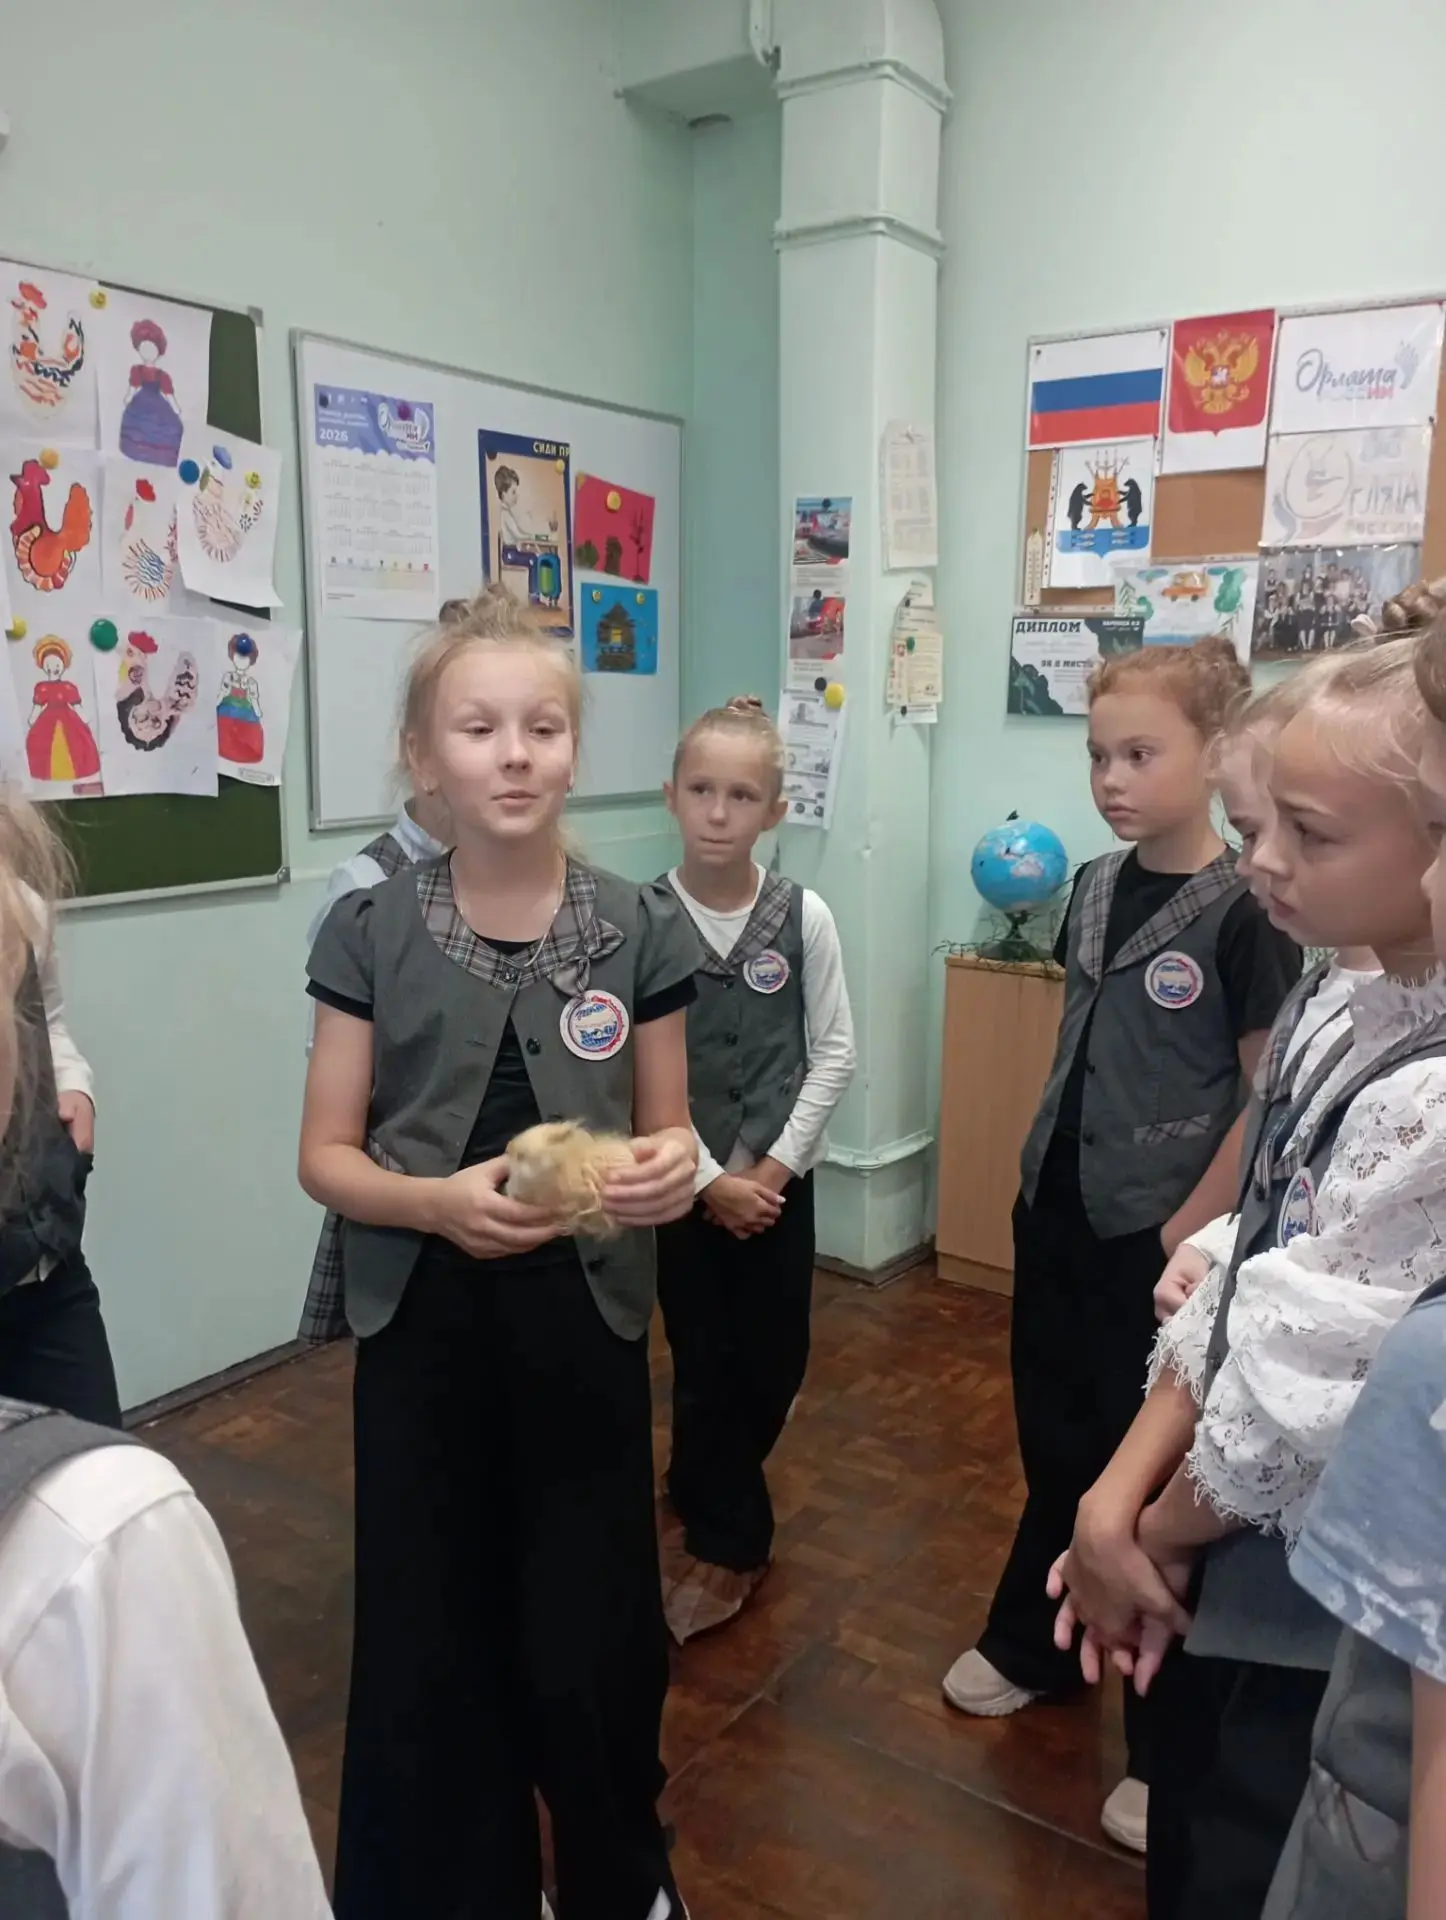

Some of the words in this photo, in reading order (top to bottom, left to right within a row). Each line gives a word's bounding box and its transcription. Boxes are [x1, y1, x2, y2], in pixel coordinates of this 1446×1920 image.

[1296, 348, 1398, 397] Орлята
[532, 441, 556, 456] СИДИ
[1015, 621, 1082, 633] ДИПЛОМ
